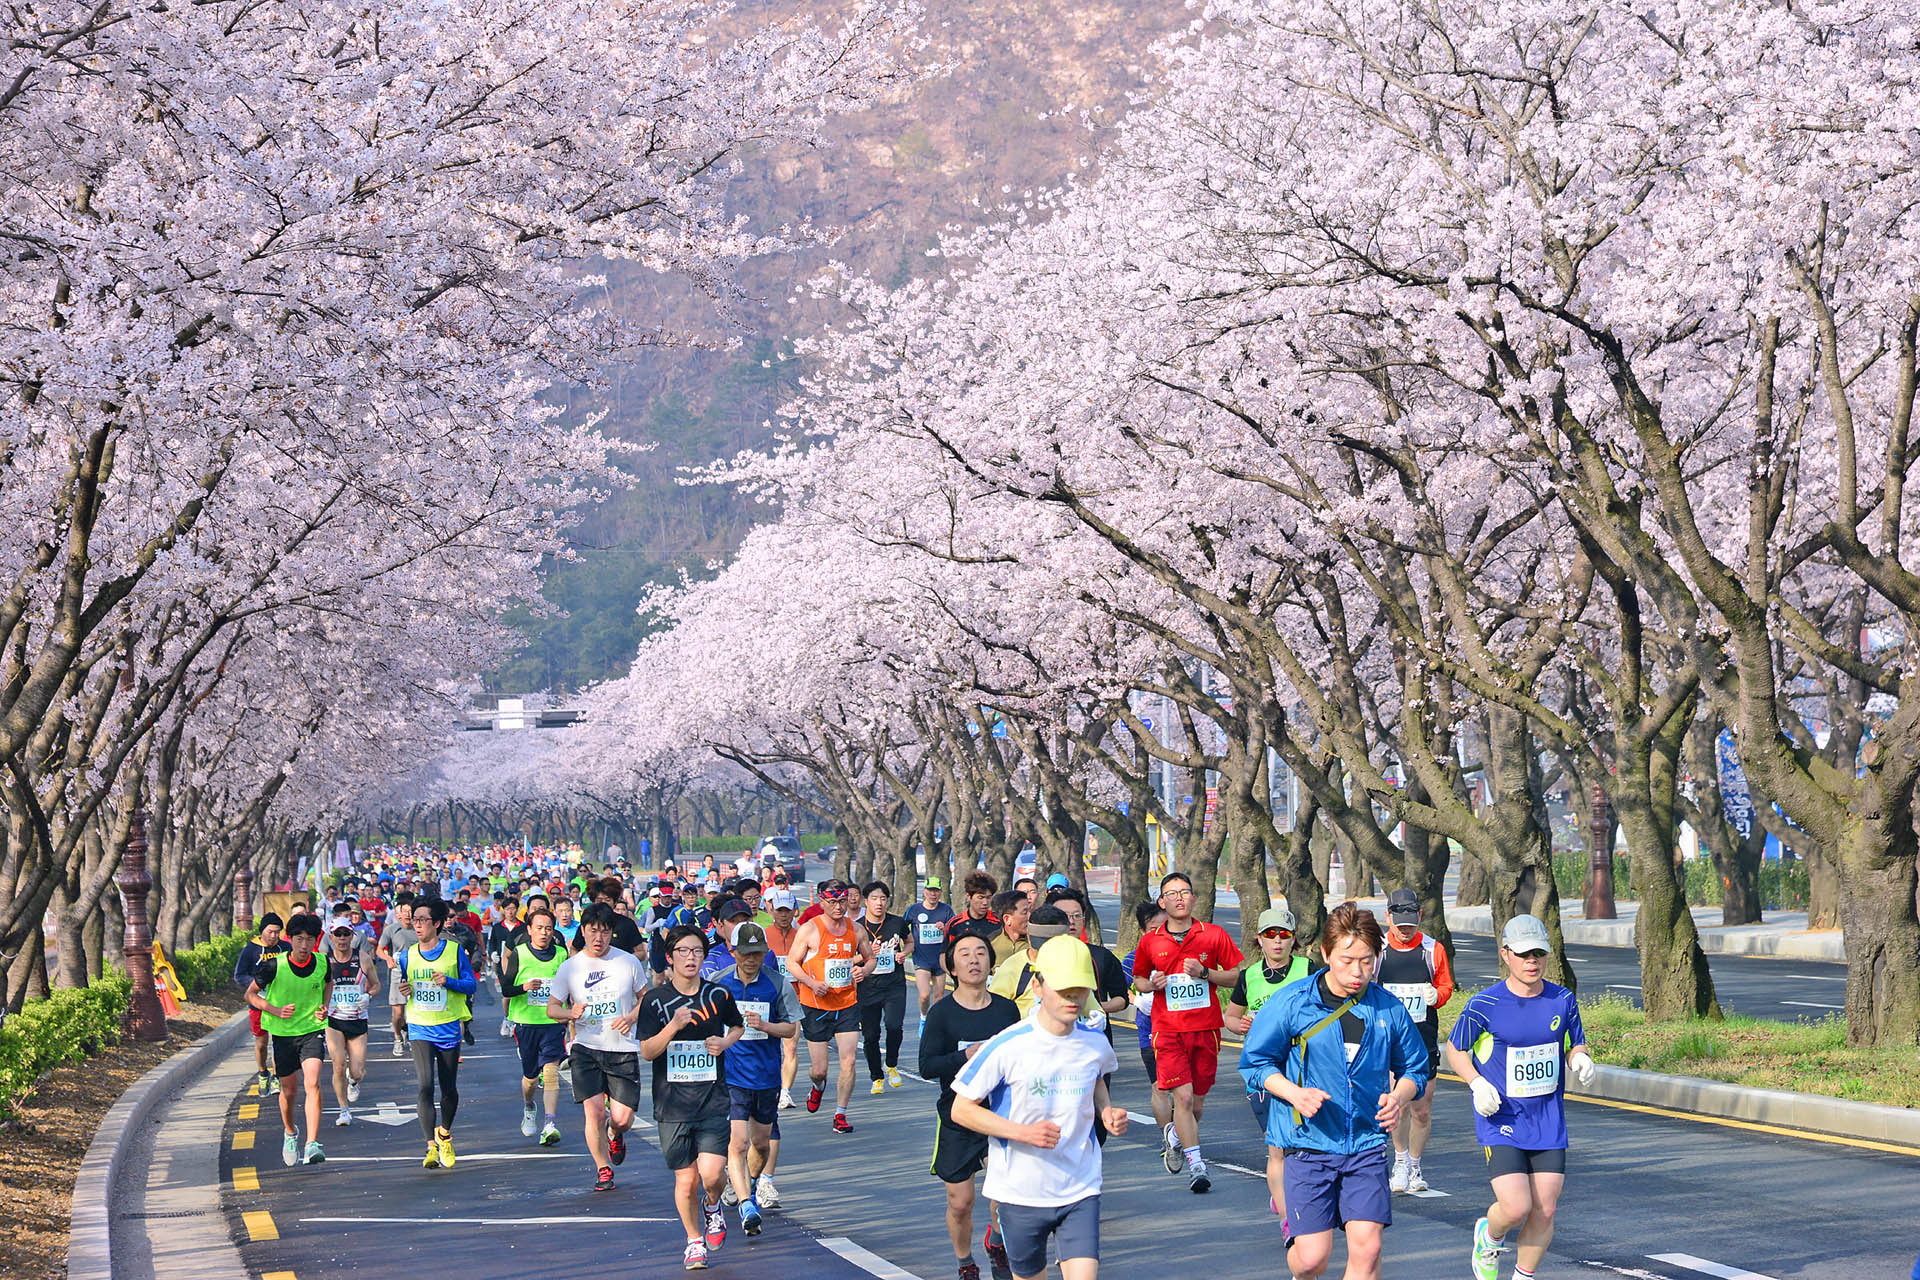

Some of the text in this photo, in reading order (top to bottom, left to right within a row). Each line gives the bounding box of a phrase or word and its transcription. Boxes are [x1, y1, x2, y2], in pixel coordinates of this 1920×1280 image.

[587, 970, 606, 981] NIKE
[416, 990, 441, 1002] 8381
[1170, 983, 1204, 999] 9205
[586, 1001, 617, 1017] 7823
[669, 1053, 714, 1069] 10460
[1514, 1060, 1554, 1081] 6980
